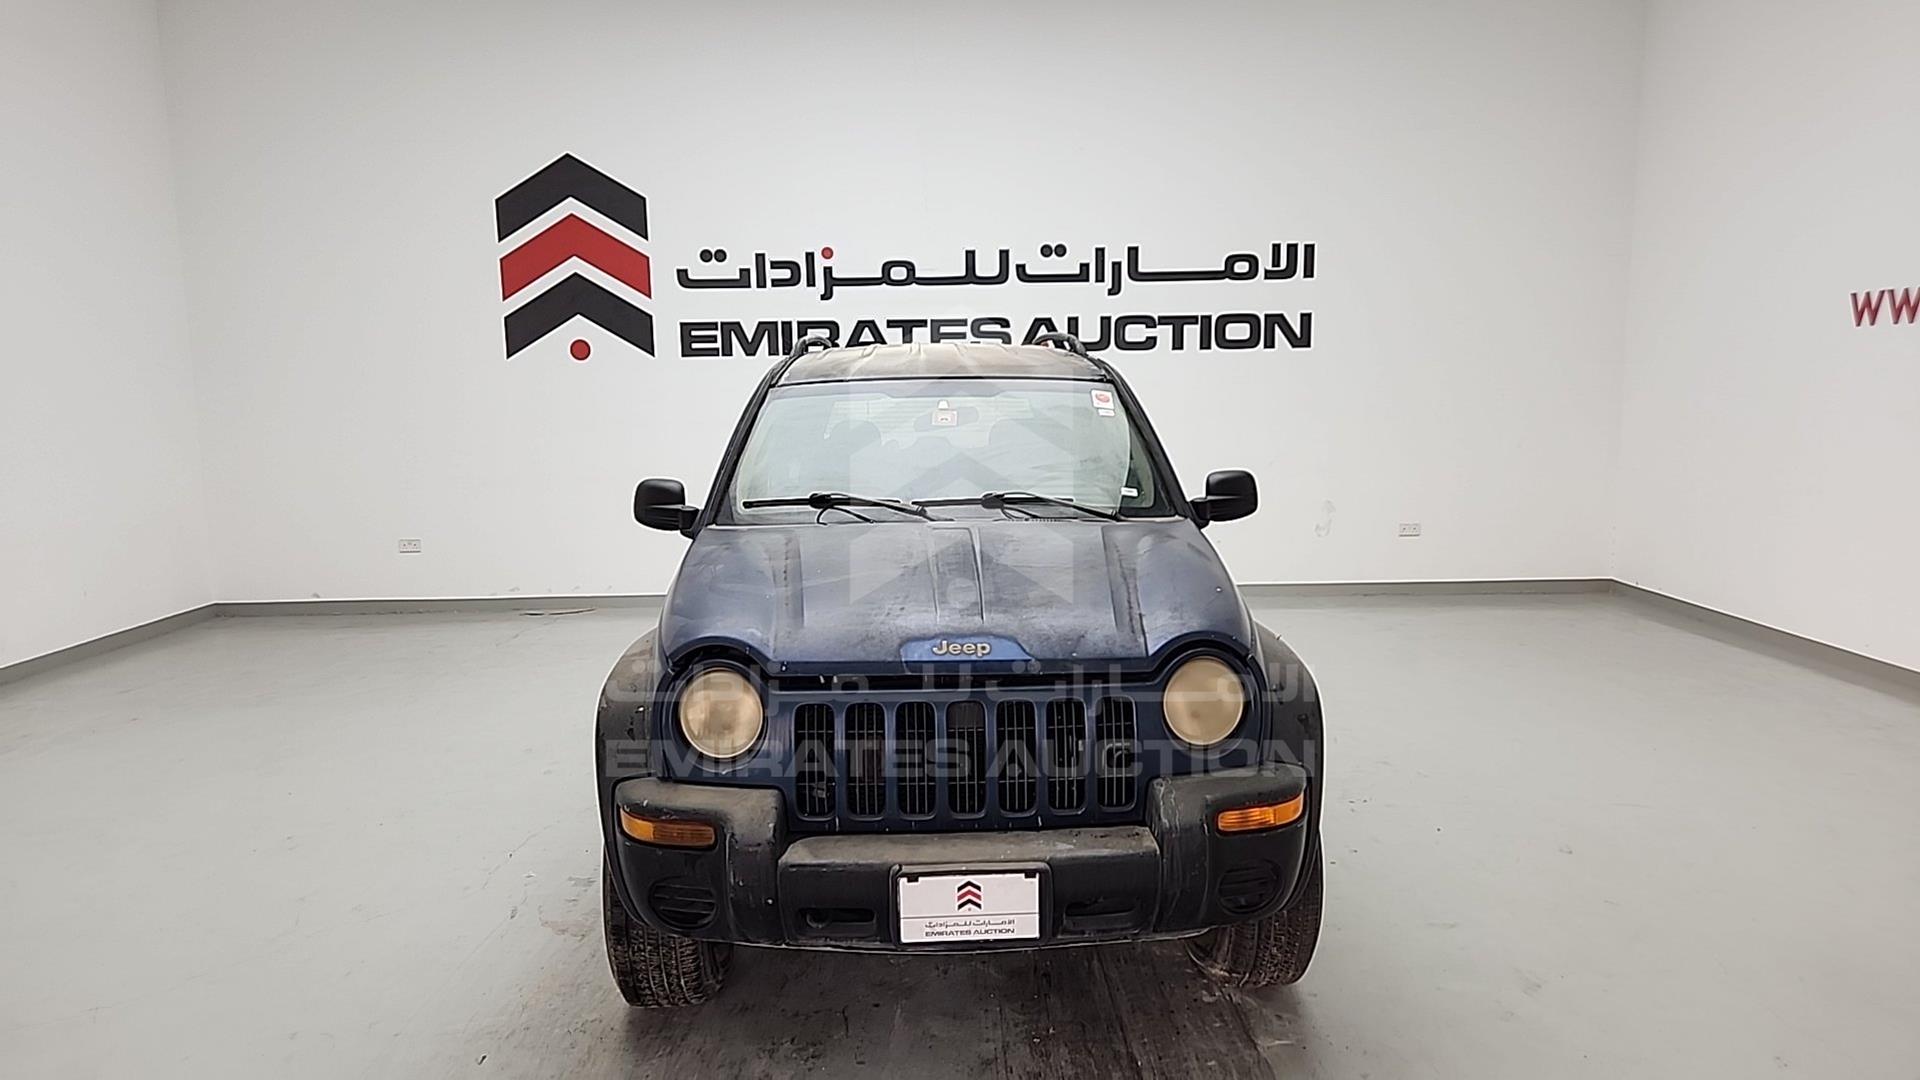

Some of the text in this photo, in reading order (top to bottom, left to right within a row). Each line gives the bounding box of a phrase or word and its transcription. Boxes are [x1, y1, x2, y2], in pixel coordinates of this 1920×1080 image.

[676, 243, 1316, 301] الامارات للمزادات
[679, 312, 1312, 357] EMIRATES AUCTION
[932, 640, 991, 657] Jeep
[925, 929, 972, 937] EMIRATES
